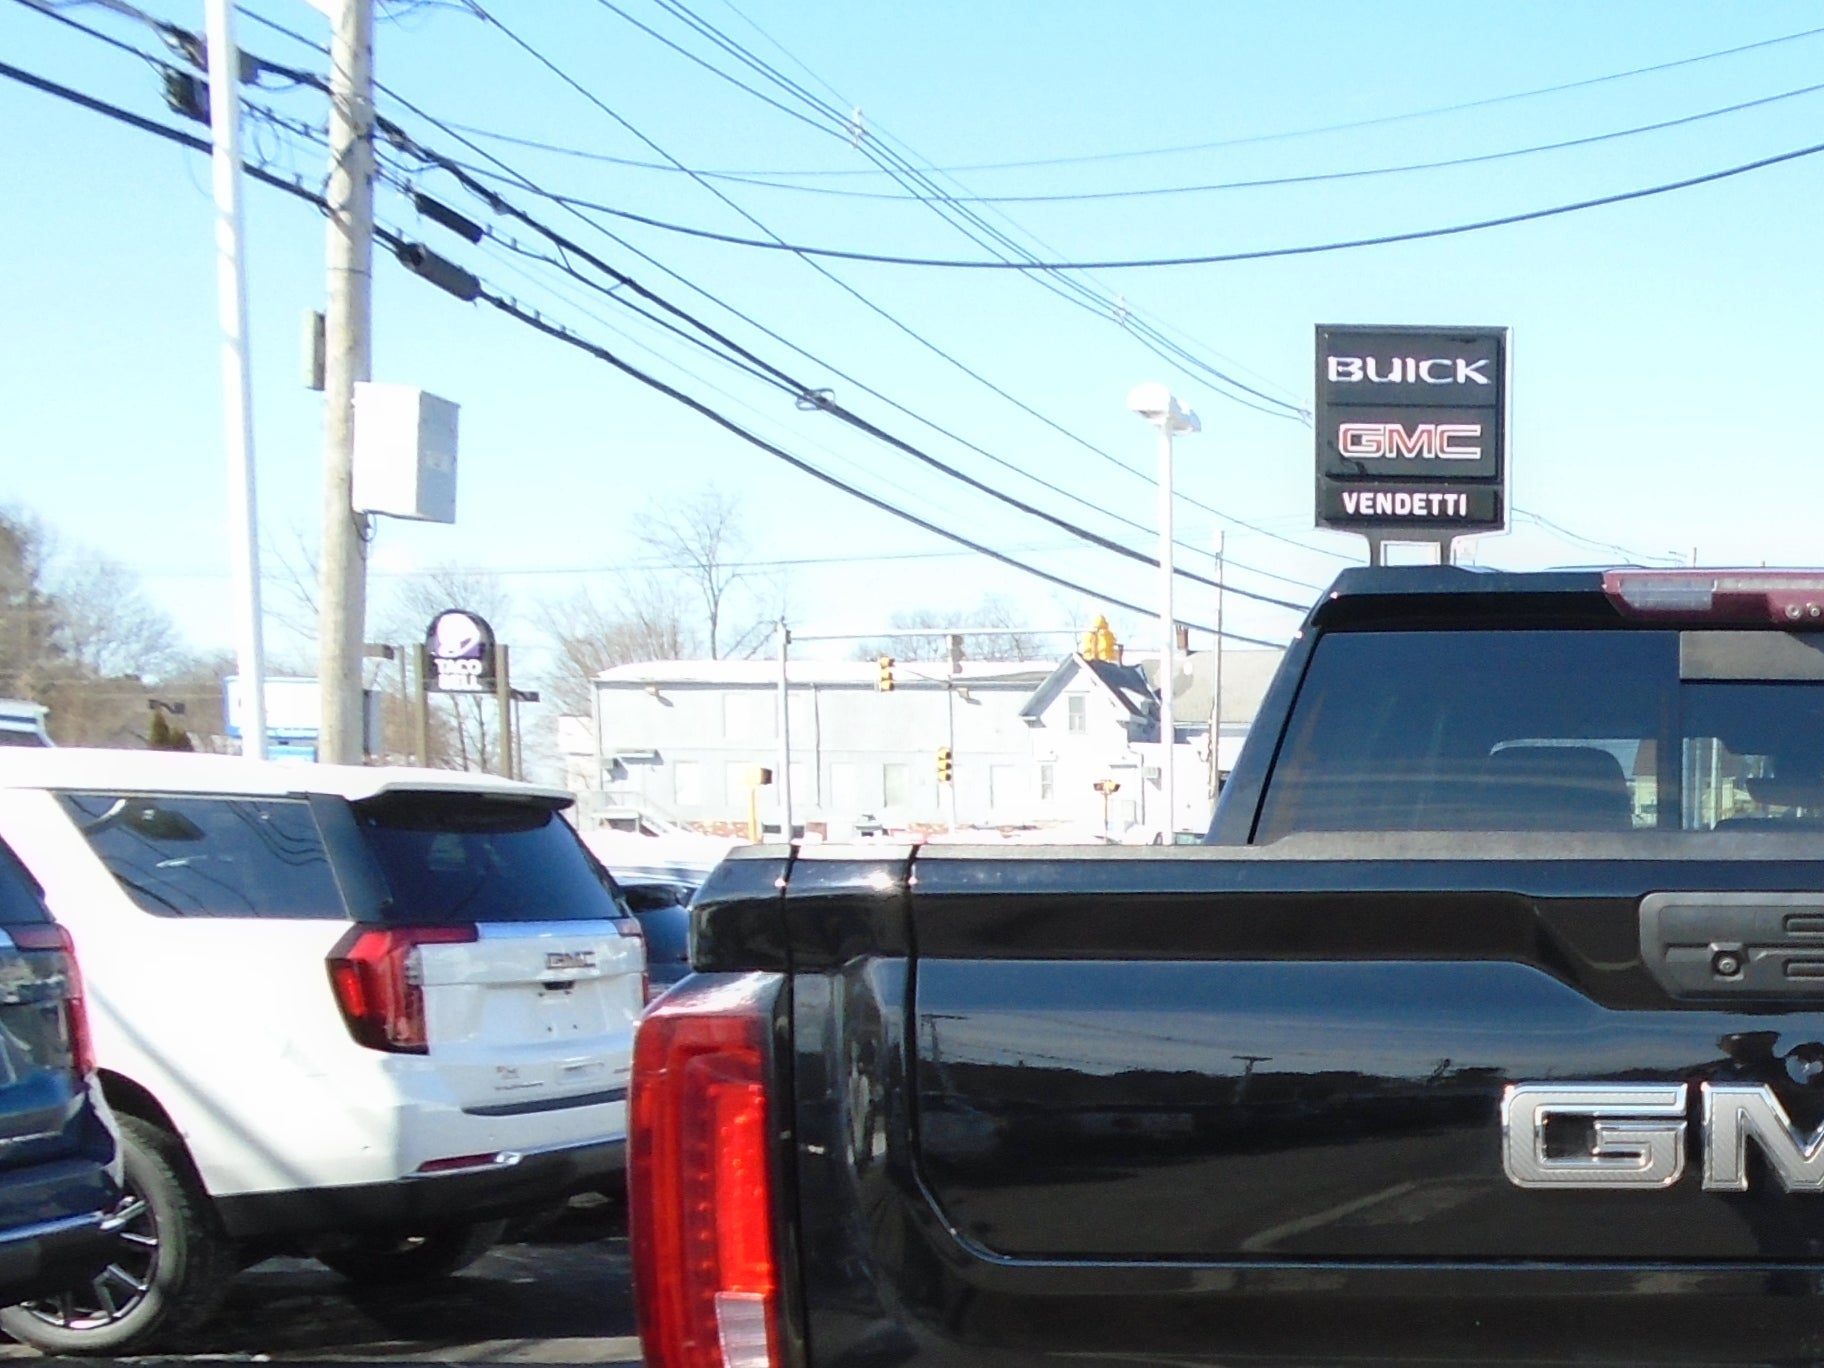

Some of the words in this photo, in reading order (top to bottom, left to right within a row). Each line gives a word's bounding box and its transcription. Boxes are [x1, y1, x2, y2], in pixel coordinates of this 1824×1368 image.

[1328, 356, 1491, 384] BUICK
[1339, 423, 1481, 459] GMC
[1342, 492, 1467, 516] VENDETTI
[434, 659, 482, 675] TACO
[546, 951, 596, 969] GMC
